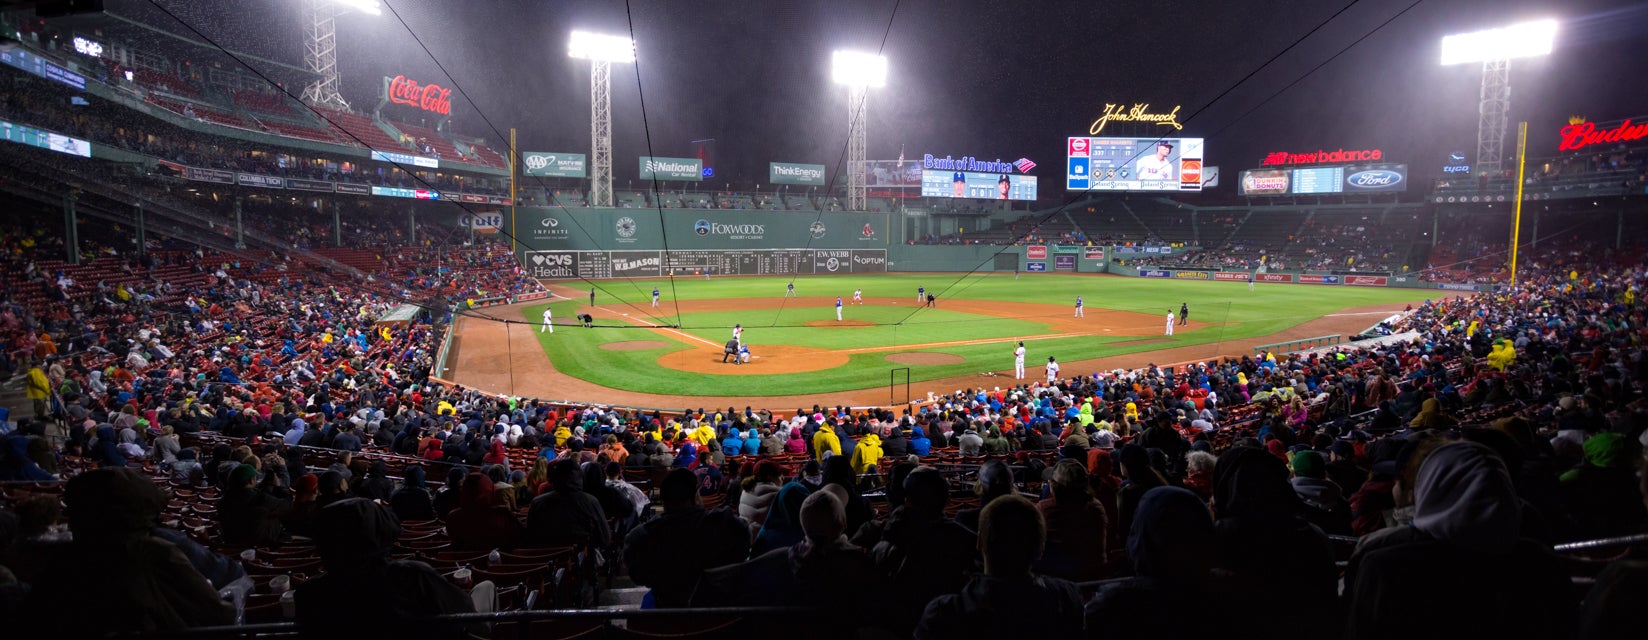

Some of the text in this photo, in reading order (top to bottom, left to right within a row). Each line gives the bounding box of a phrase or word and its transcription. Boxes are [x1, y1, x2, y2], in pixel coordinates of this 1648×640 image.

[1090, 103, 1183, 135] John Hancock
[924, 153, 1013, 173] Bank of America
[1288, 153, 1318, 165] new
[1318, 149, 1383, 163] balance
[657, 162, 698, 173] National
[774, 166, 821, 178] ThinkEnergy
[1443, 165, 1470, 173] tyco
[1358, 172, 1391, 185] Ford
[461, 214, 500, 226] Gulf
[711, 222, 765, 235] FOXWOODS
[545, 254, 573, 266] CVS
[830, 250, 849, 258] WEBB
[860, 257, 885, 265] OPTUM
[534, 266, 573, 277] Health
